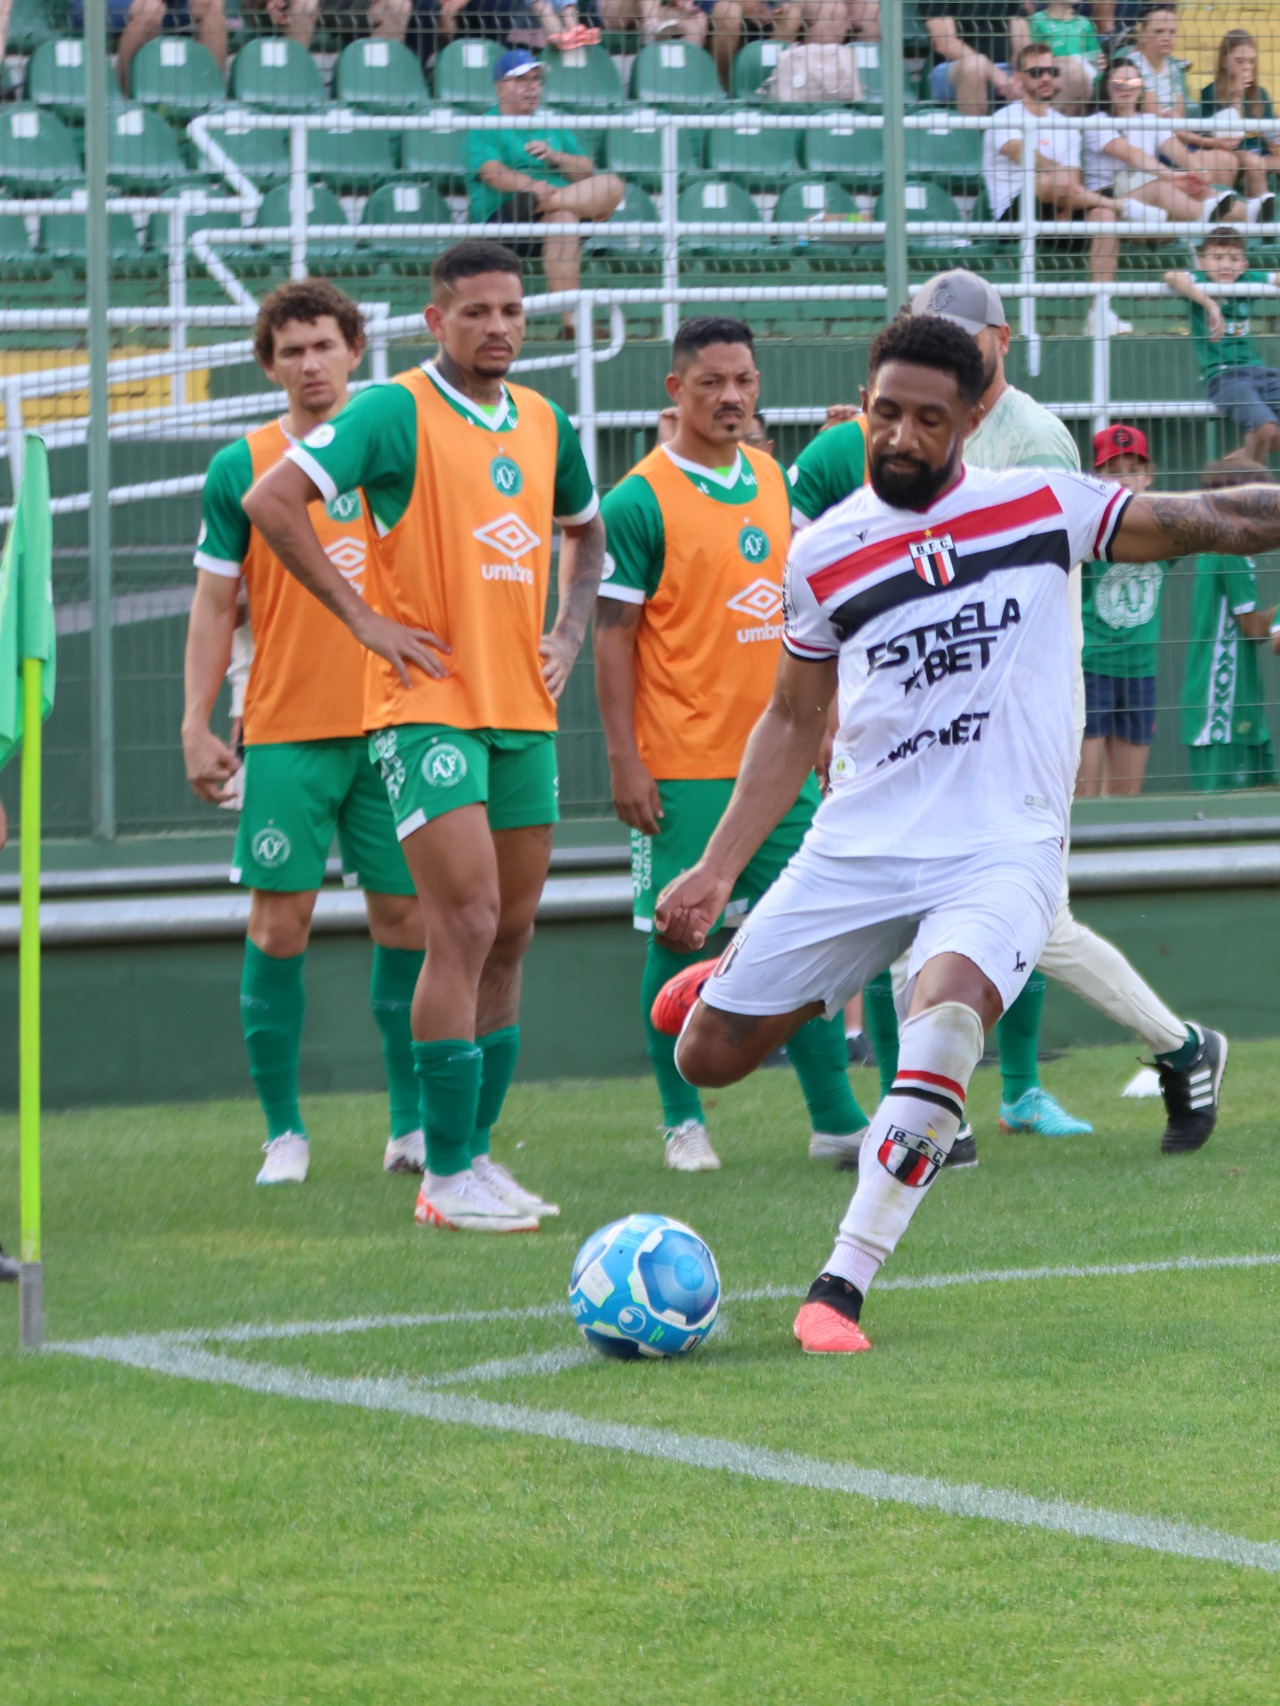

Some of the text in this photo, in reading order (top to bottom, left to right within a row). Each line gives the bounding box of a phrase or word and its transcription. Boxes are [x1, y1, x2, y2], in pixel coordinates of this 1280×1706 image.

[482, 562, 535, 586] umbro
[736, 622, 786, 643] umbr
[866, 598, 1021, 677] ESTRELA
[923, 636, 998, 687] BET
[642, 835, 653, 890] RUPO
